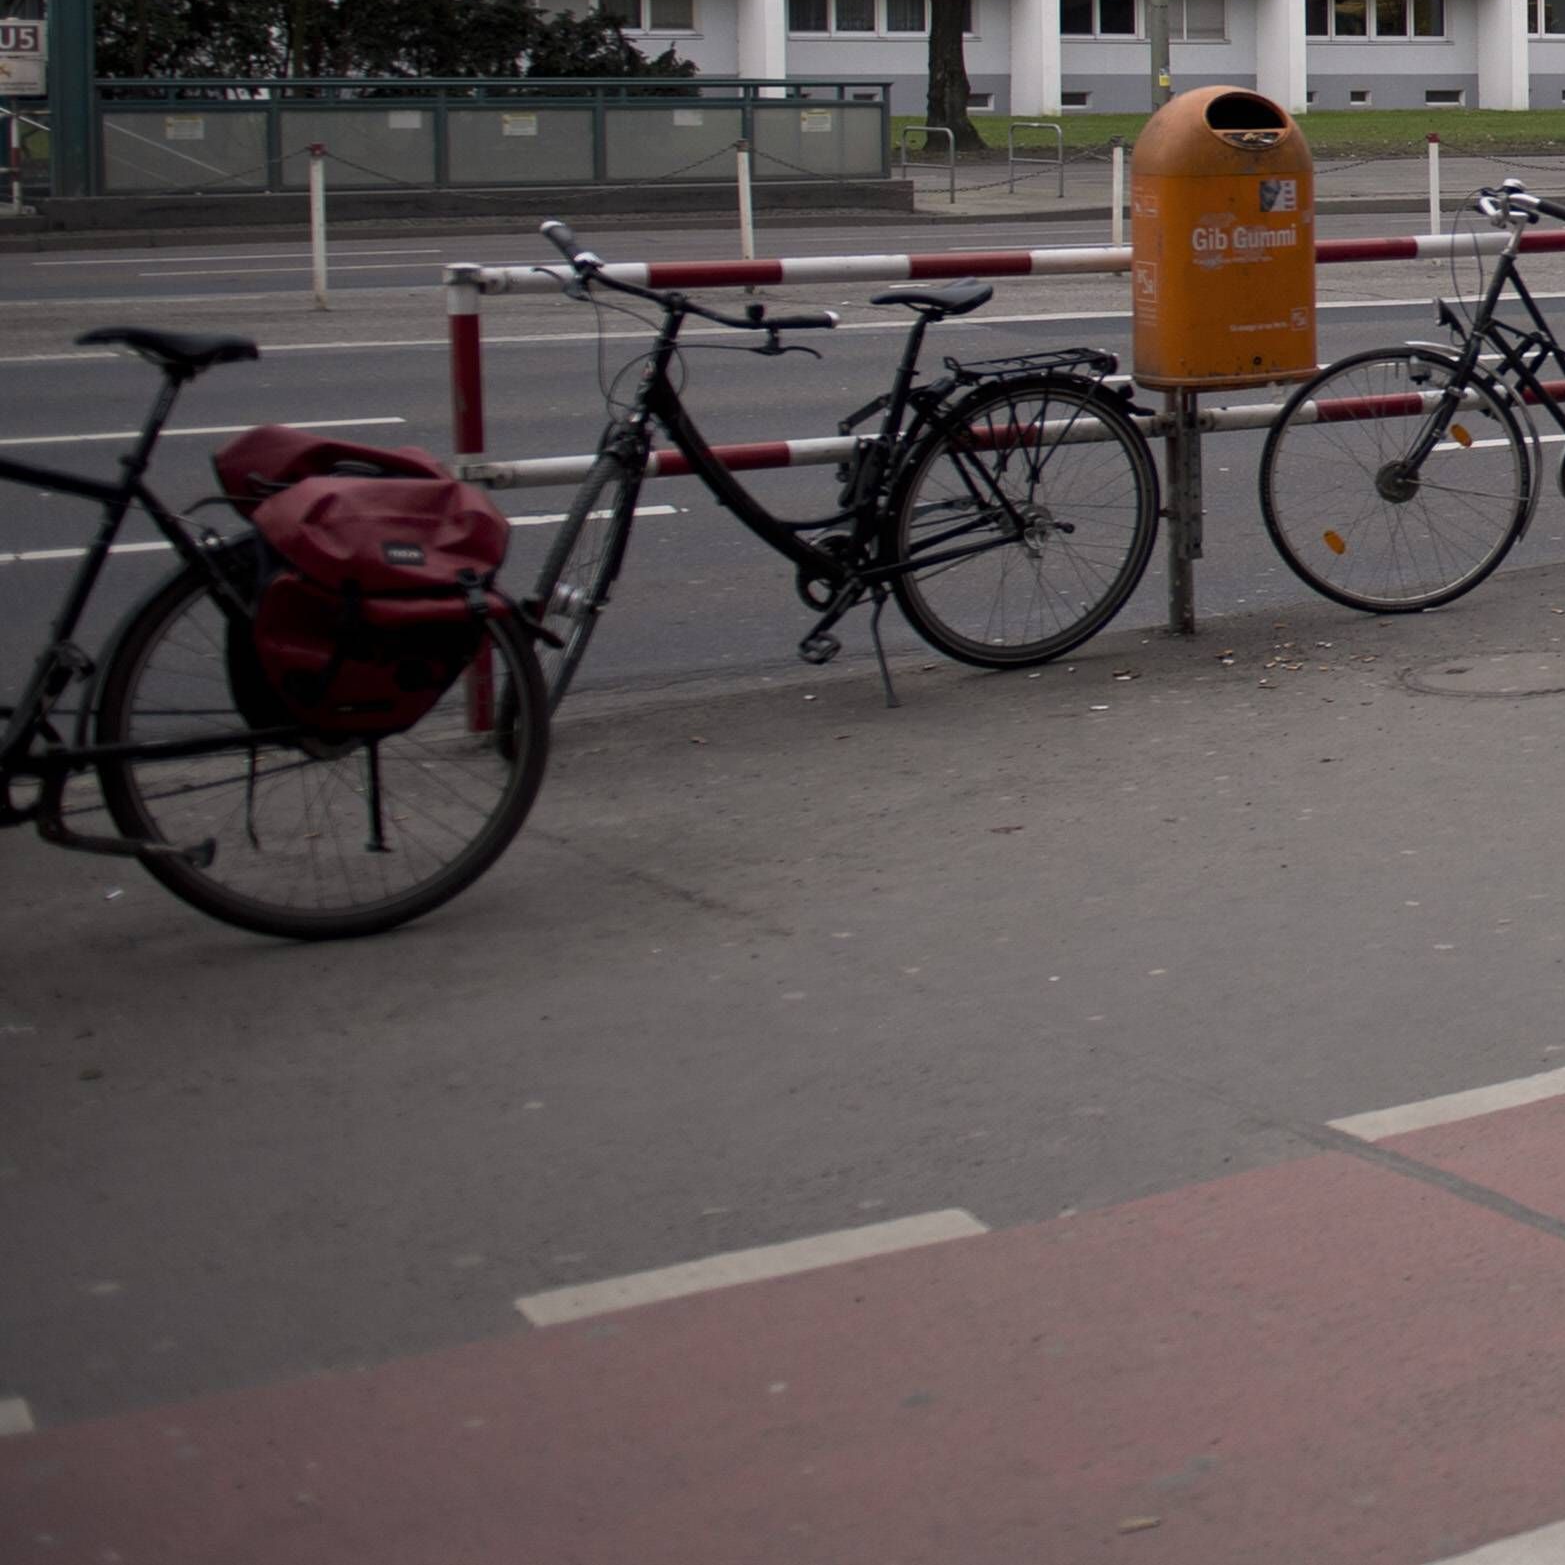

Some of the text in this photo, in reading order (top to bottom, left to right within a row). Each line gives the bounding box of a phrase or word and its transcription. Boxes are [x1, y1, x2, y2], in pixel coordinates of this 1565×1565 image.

[0, 27, 35, 50] U5
[1192, 224, 1297, 250] Gib Gummi
